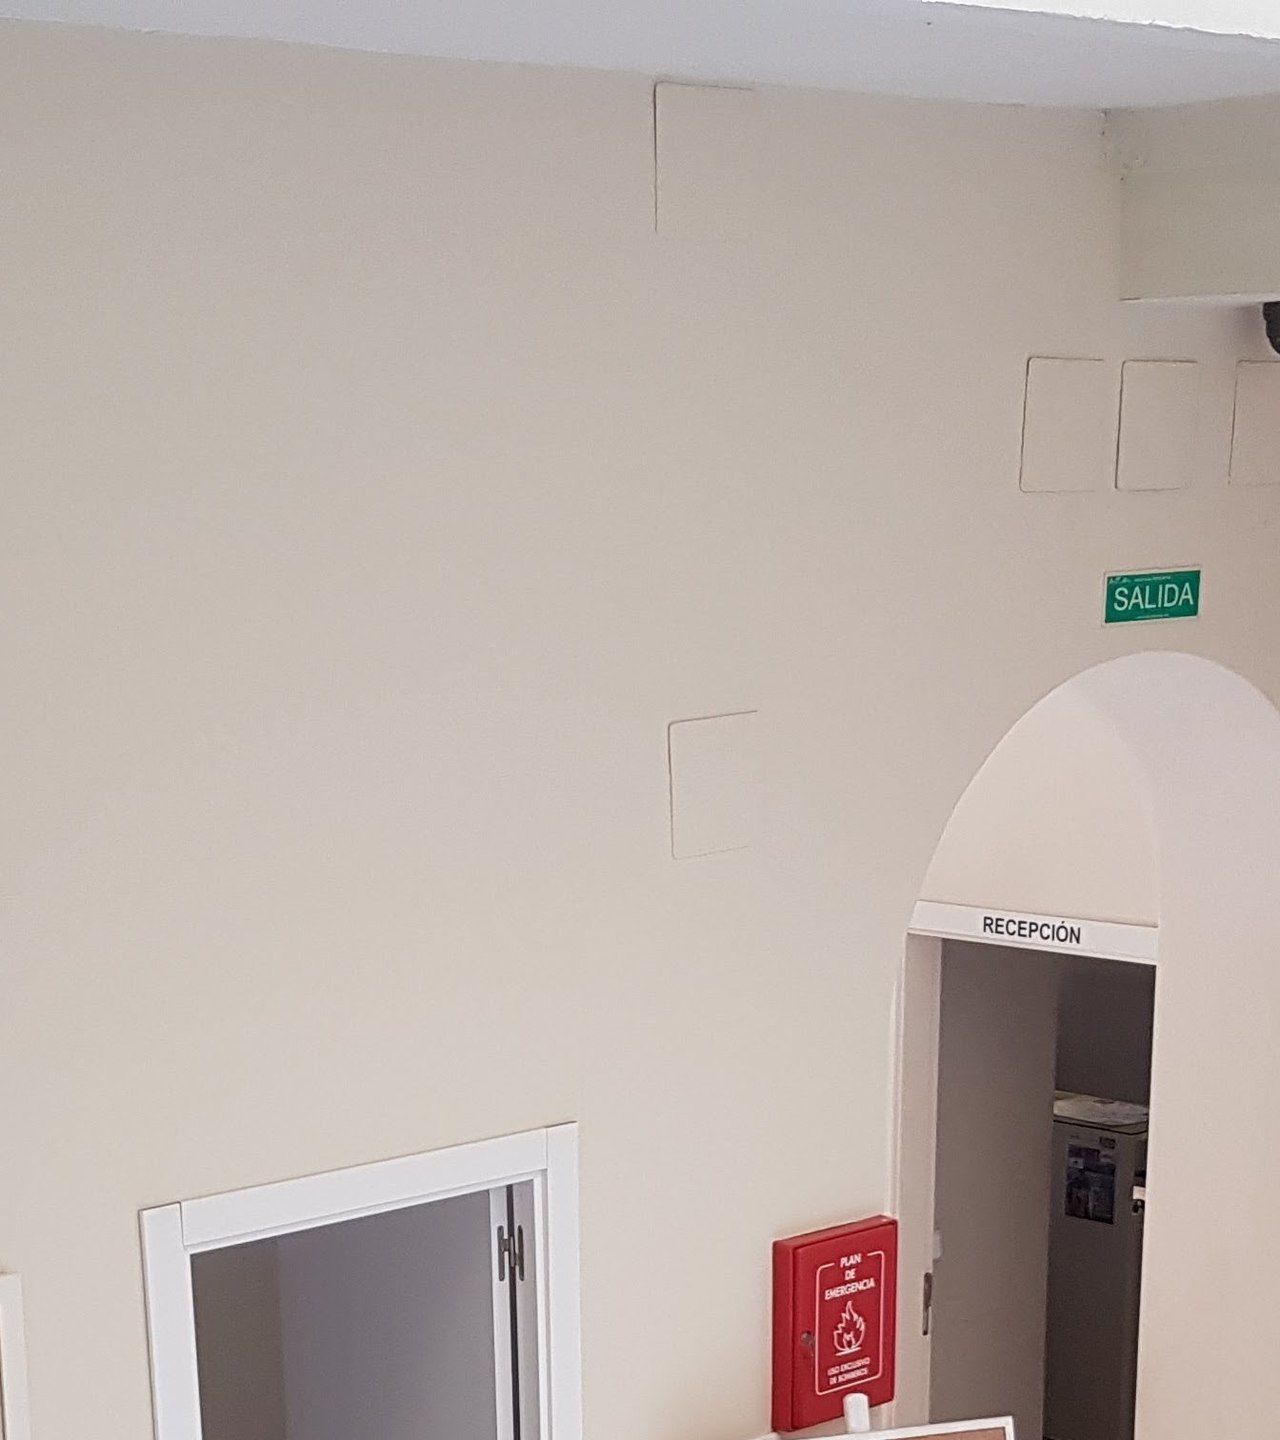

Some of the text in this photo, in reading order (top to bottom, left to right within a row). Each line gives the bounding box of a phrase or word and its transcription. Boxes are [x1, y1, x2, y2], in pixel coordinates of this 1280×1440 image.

[1113, 582, 1194, 611] SALIDA
[983, 916, 1081, 944] RECEPCIÓN
[840, 1253, 862, 1268] PLAN
[844, 1268, 856, 1281] DE
[824, 1277, 876, 1301] EMERGENCIA
